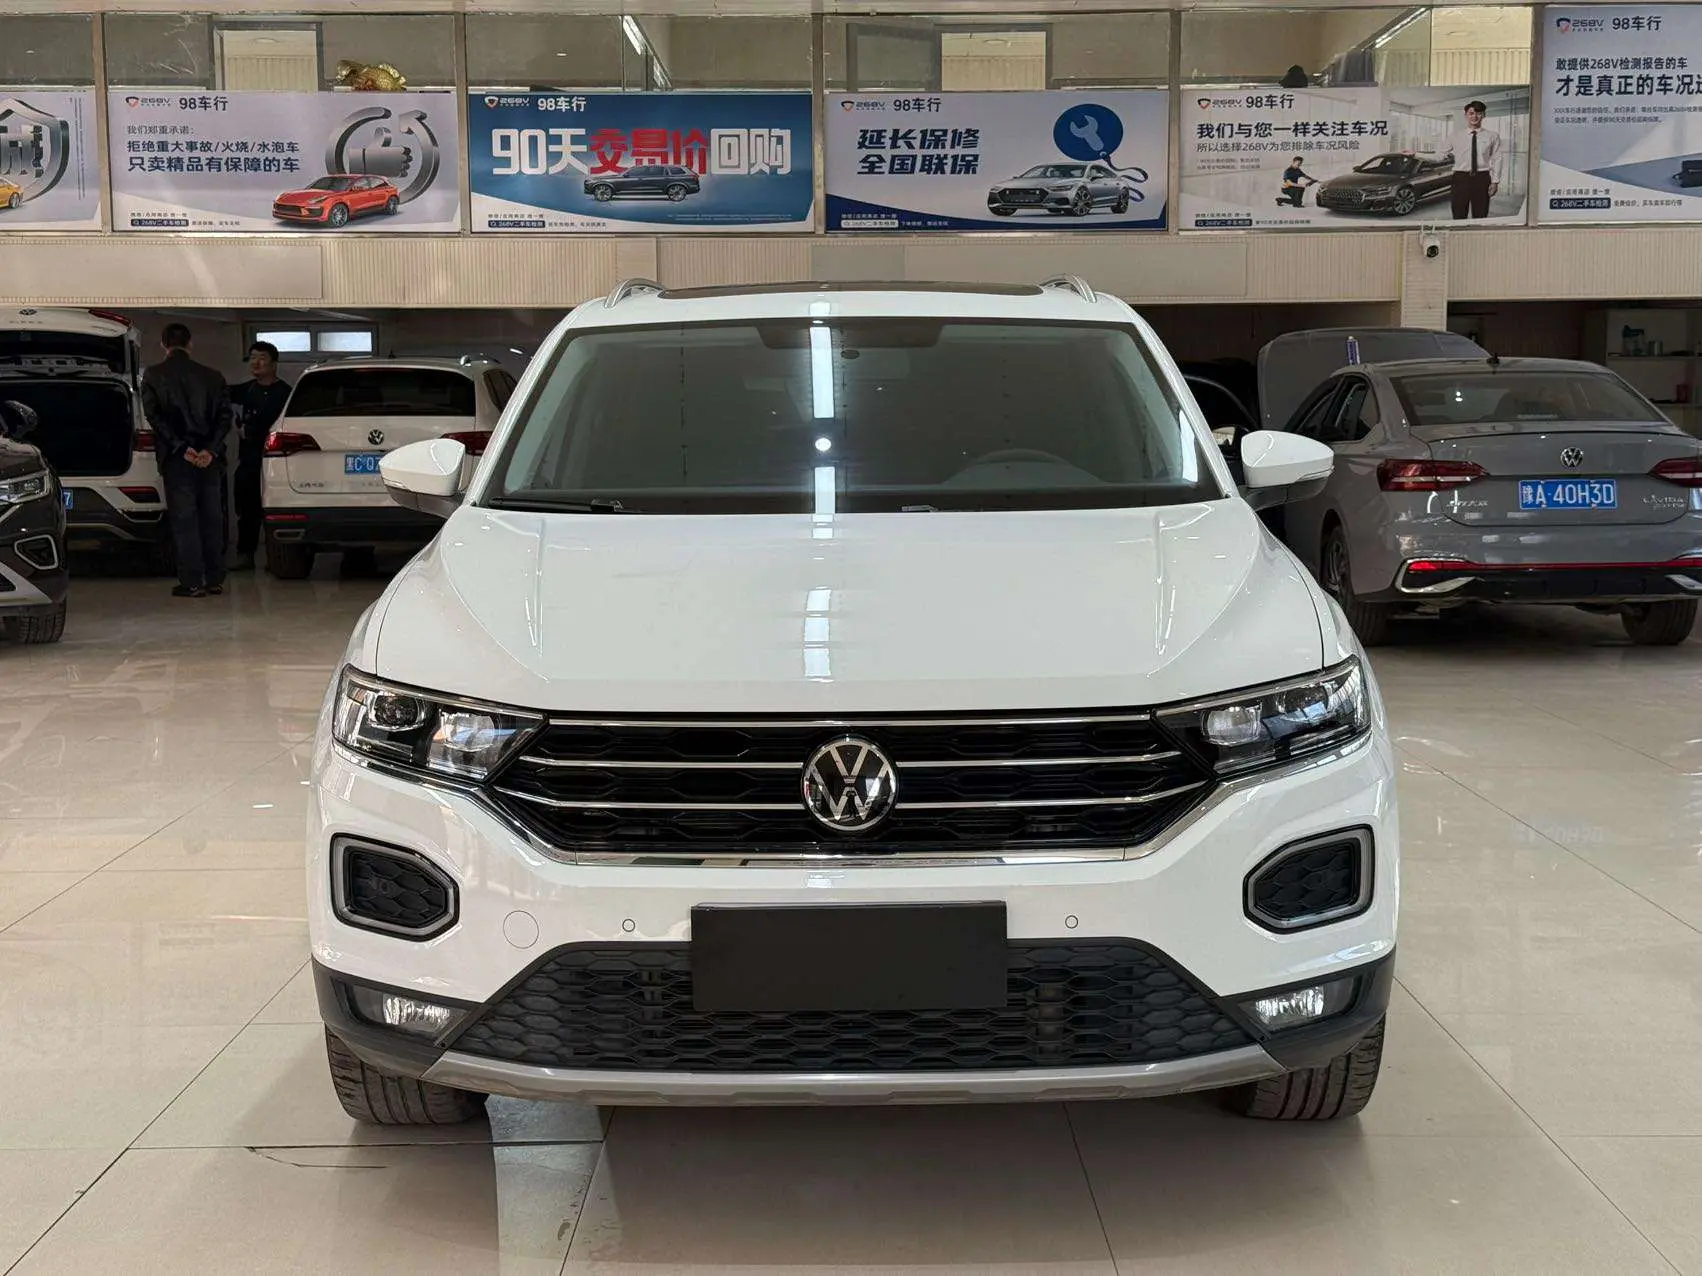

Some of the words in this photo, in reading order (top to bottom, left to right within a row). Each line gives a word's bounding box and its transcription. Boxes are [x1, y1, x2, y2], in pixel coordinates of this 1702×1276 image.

[1571, 19, 1604, 27] 268V
[1612, 16, 1662, 31] 98车行
[1556, 57, 1688, 71] 敢提供268V检测报告的车
[179, 96, 228, 111] 98车行
[537, 96, 586, 112] 98车行
[893, 98, 941, 112] 98车行
[1246, 94, 1295, 109] 98车行
[1197, 120, 1389, 139] 我们与您一样关注车况
[127, 140, 300, 153] 拒绝重大事故/火烧/水泡车
[857, 128, 980, 150] 延长保修
[1195, 140, 1361, 153] 所以选择268V为您排除车况风险
[491, 128, 792, 175] 90天交易价回购
[127, 156, 300, 173] 只卖精品有保障的车
[857, 153, 979, 175] 全国联保
